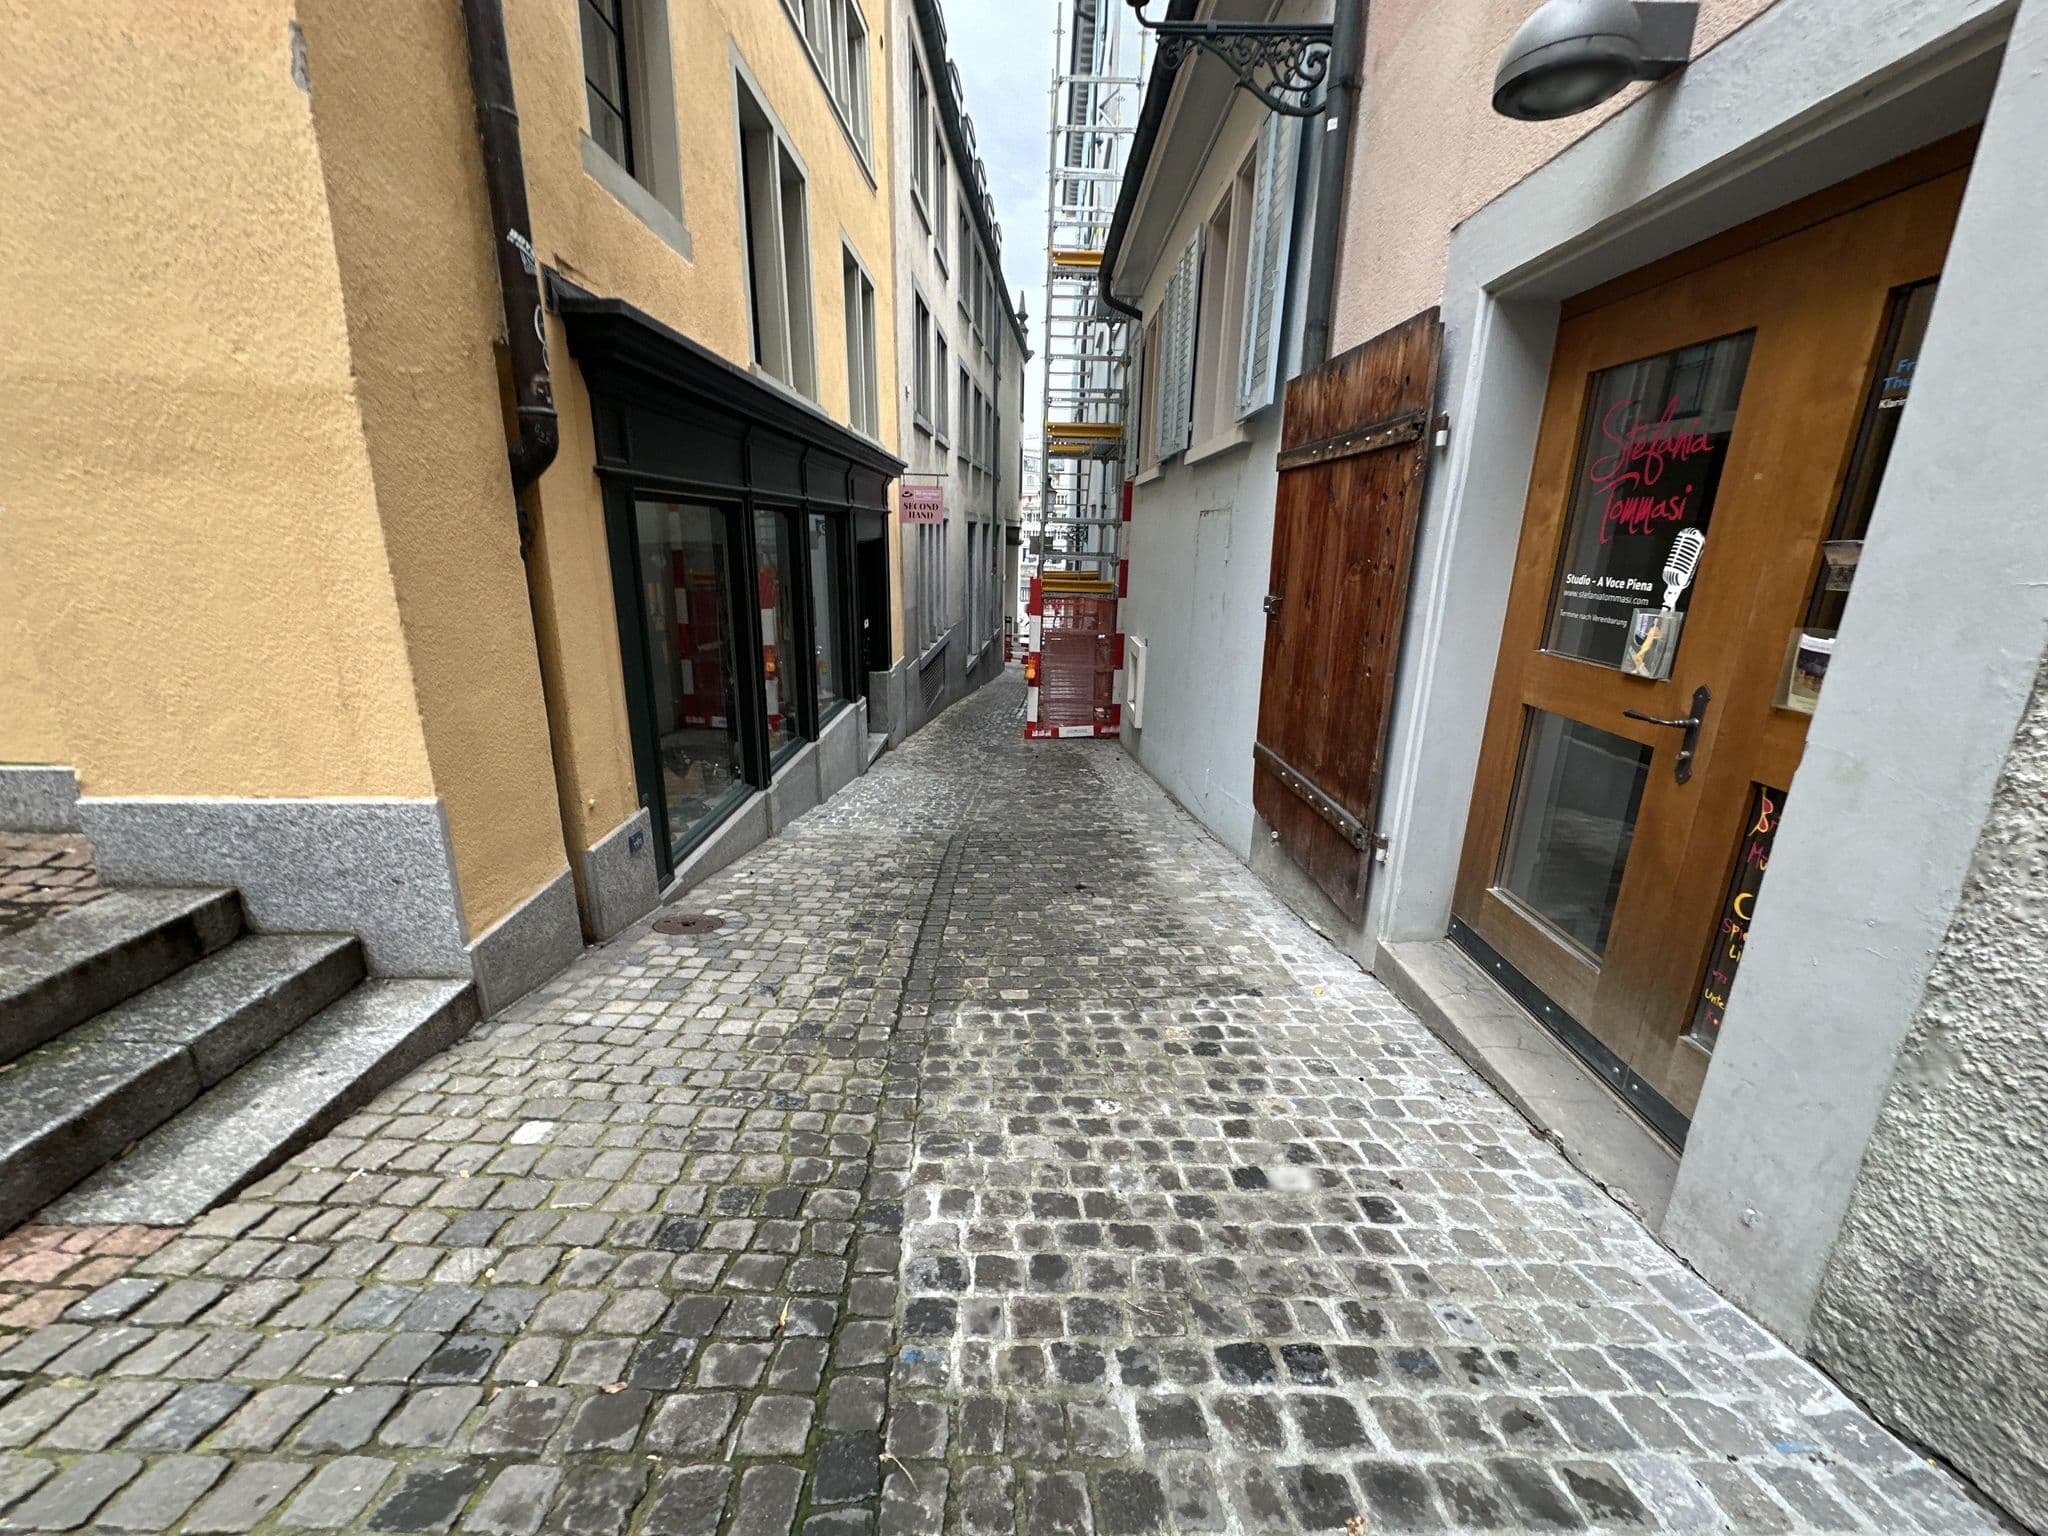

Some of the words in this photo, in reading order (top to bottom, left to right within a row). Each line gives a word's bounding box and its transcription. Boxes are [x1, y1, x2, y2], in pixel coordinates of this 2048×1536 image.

[1896, 359, 1915, 373] Fr
[1590, 394, 1714, 485] Stefania
[903, 502, 939, 510] SECOND
[908, 511, 934, 519] HAND
[1594, 471, 1693, 544] Tommasi
[1566, 573, 1591, 585] Studio
[1597, 576, 1604, 587] A
[1605, 577, 1625, 589] Voce
[1626, 578, 1653, 592] Piena
[1563, 589, 1649, 606] www.stefaniatommasi.com
[1704, 988, 1724, 1010] Unte
